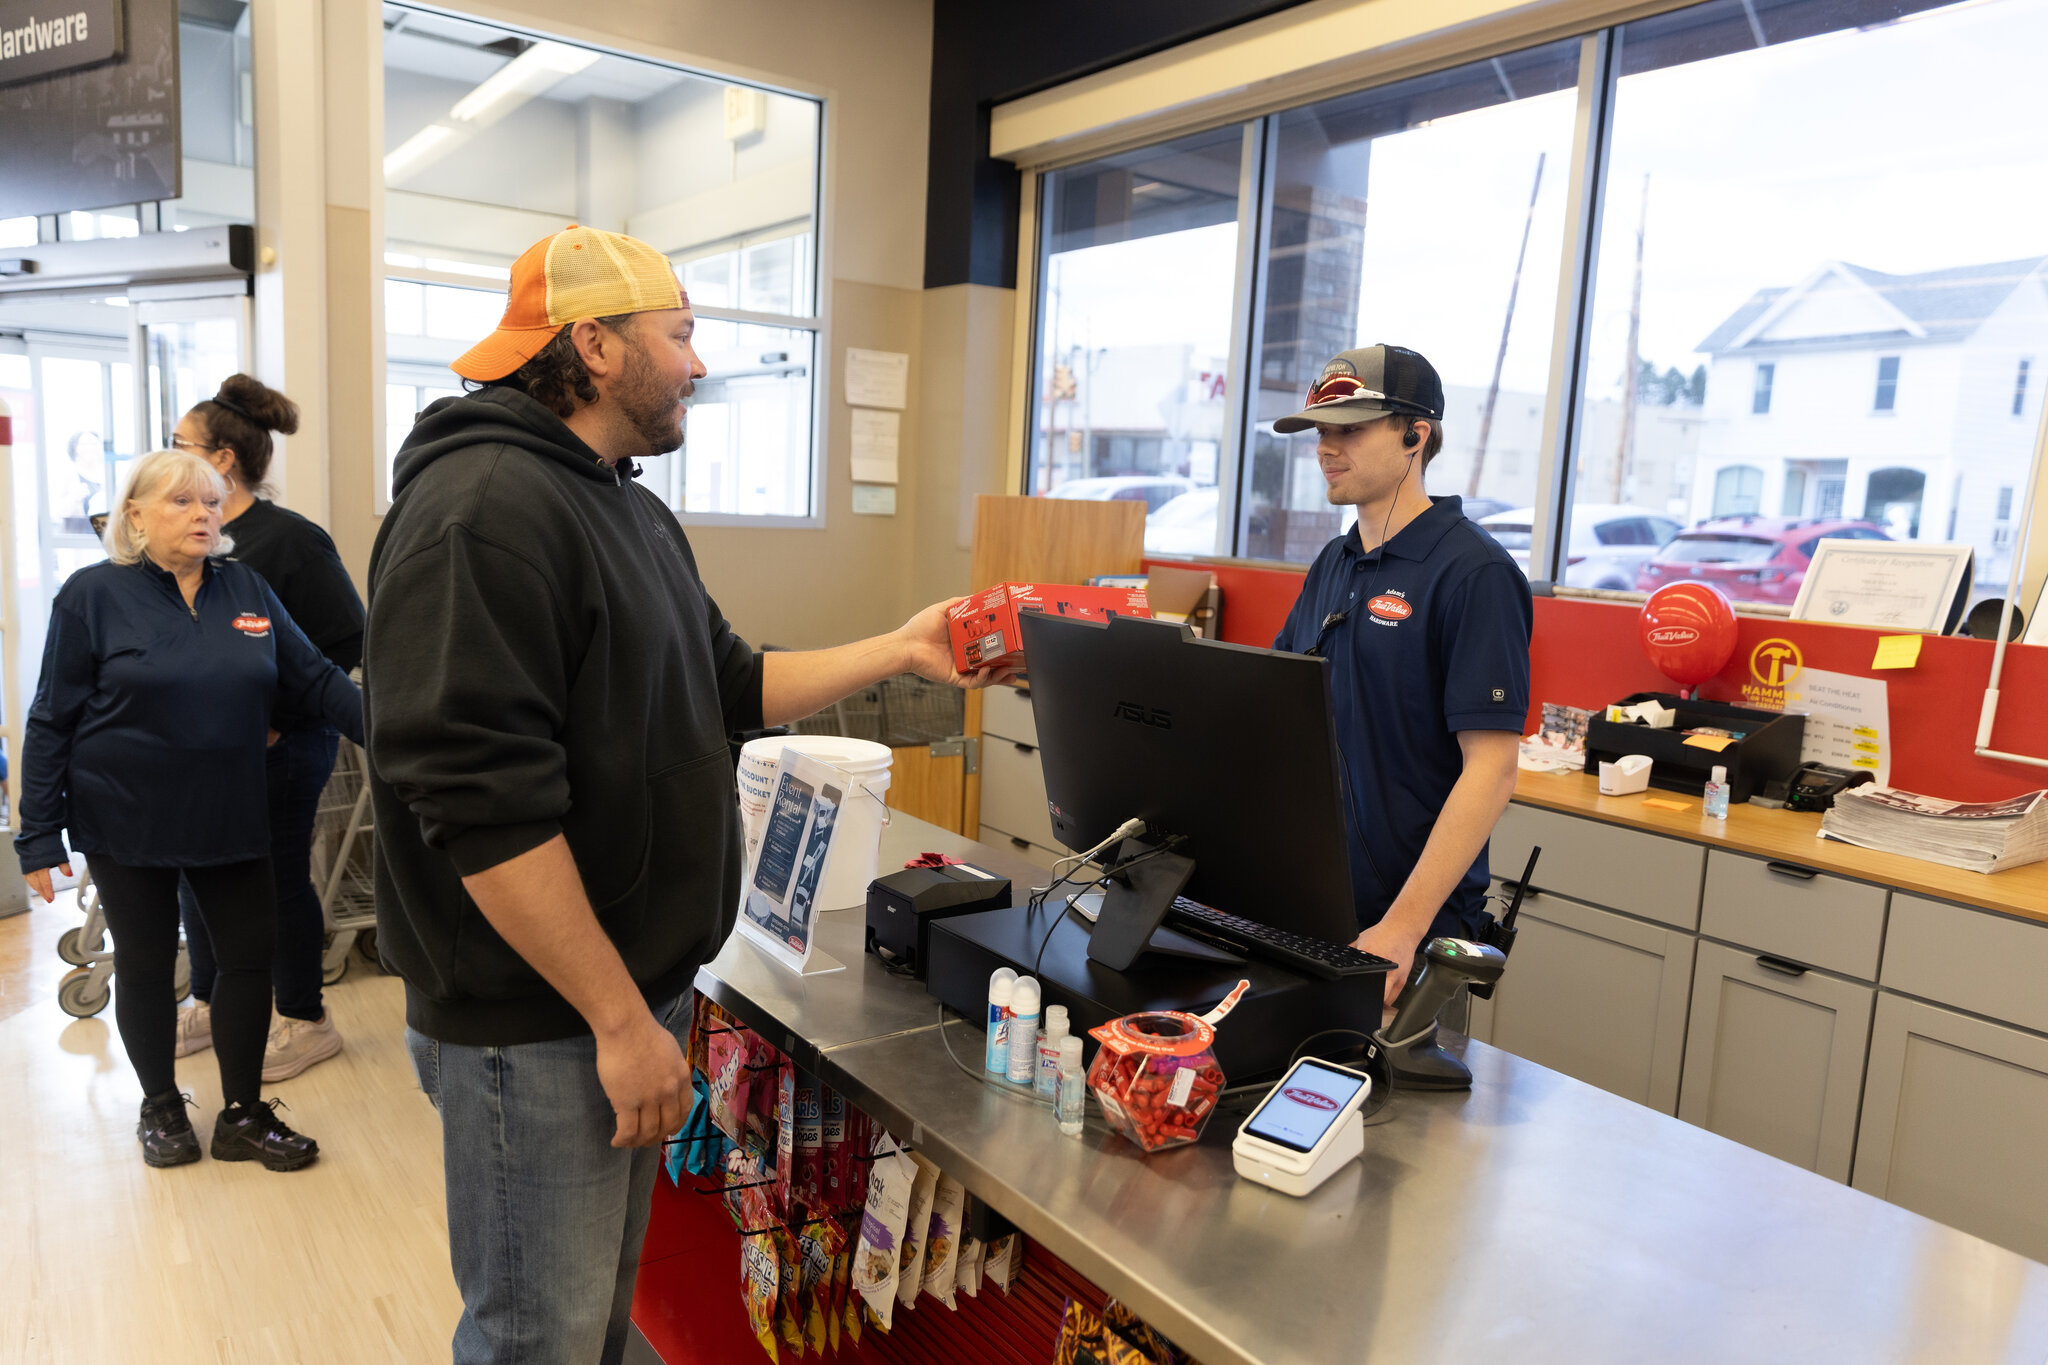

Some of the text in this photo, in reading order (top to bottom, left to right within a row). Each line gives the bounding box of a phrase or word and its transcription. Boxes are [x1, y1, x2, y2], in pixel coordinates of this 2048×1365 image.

[1369, 614, 1399, 627] HARDWARE
[1742, 685, 1802, 701] HAMMER
[1809, 684, 1861, 699] BEAT THE HEAT
[1819, 699, 1862, 713] Conditioners
[1113, 701, 1172, 730] ASUS
[741, 767, 769, 785] DISCOUNT
[746, 785, 771, 799] BUCKET
[780, 775, 802, 799] Event
[776, 789, 803, 816] Rental
[863, 1224, 879, 1244] trail mix
[865, 1216, 880, 1236] tropical
